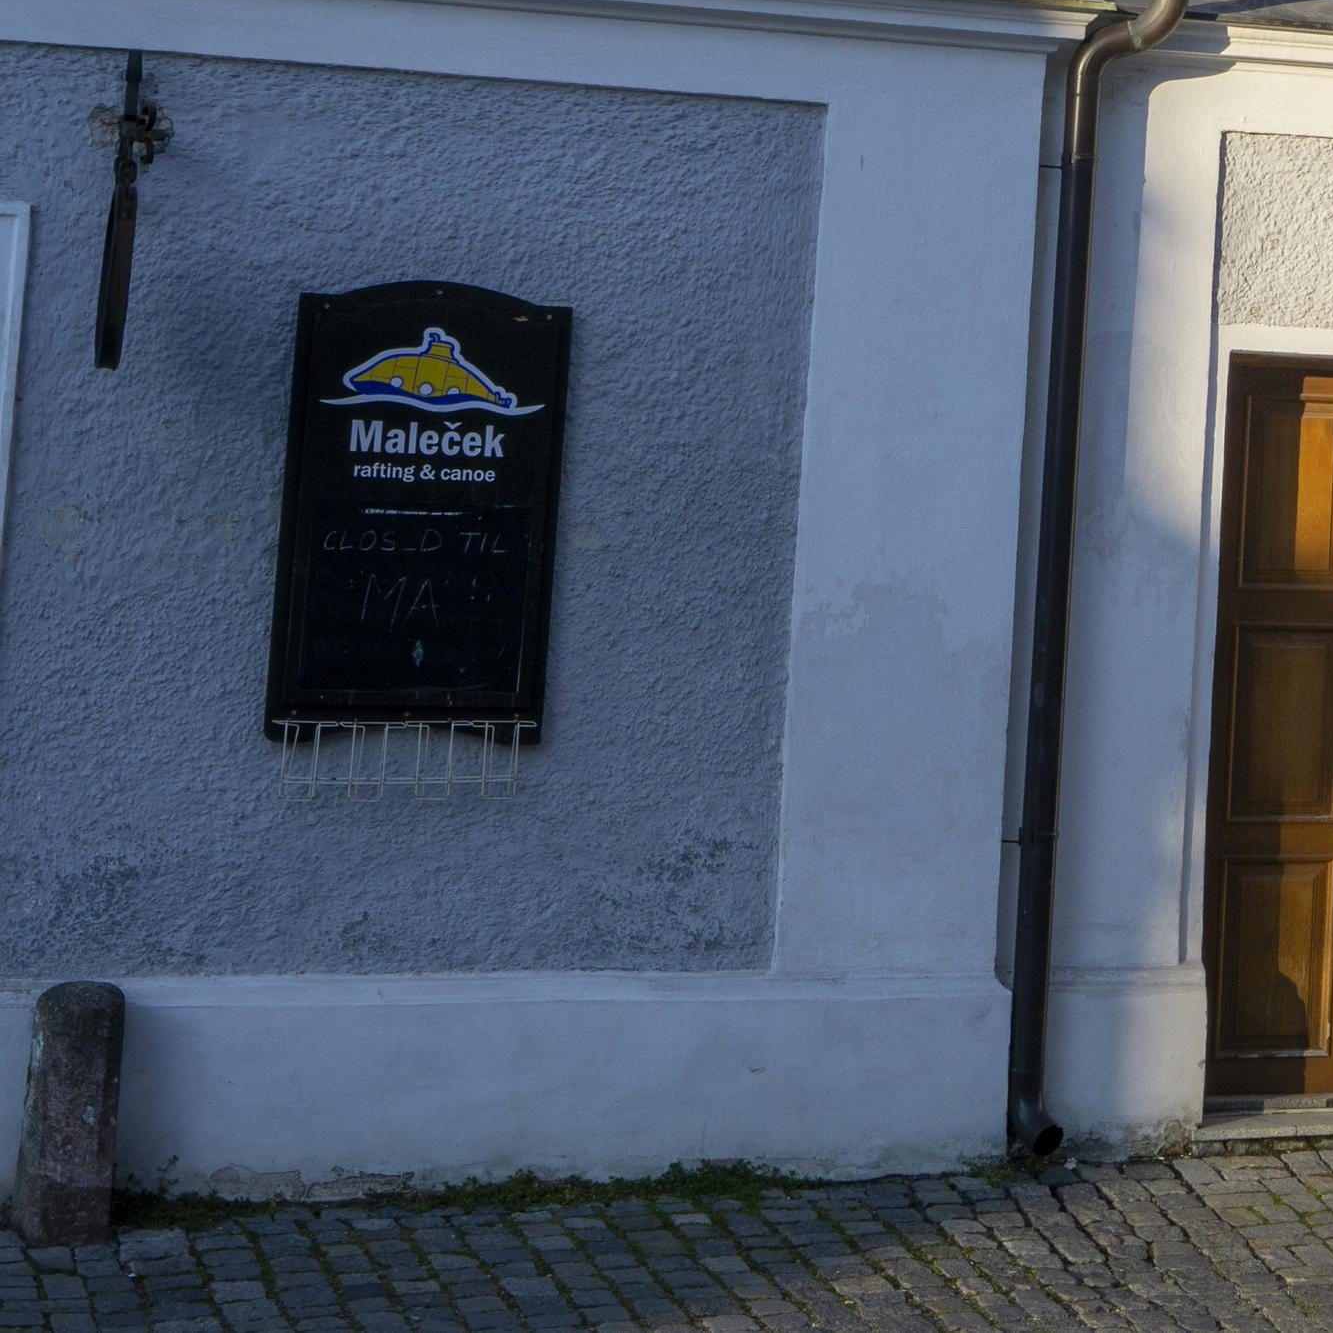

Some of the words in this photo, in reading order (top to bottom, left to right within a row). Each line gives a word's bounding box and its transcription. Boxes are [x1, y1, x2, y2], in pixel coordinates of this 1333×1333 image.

[349, 419, 505, 458] Maleček
[353, 462, 415, 483] rafting
[420, 464, 436, 481] &
[440, 466, 496, 483] canoe
[323, 528, 443, 555] CLOSD
